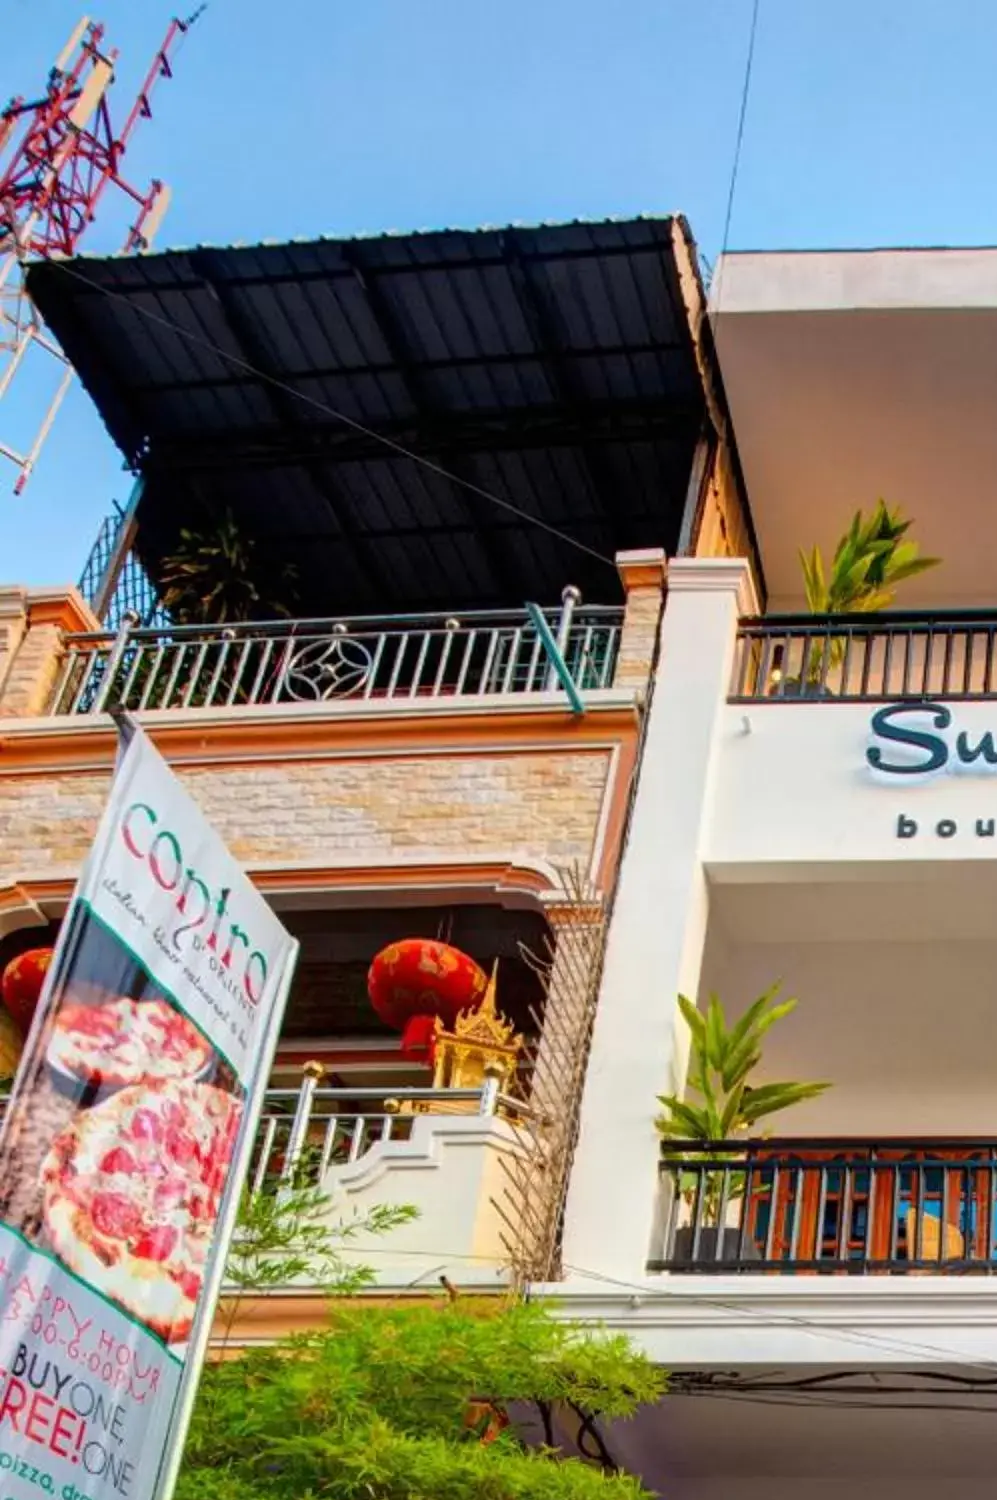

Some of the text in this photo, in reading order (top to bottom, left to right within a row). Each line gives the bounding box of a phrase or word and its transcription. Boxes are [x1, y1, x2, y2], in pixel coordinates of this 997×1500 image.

[11, 1343, 72, 1401] BUY
[99, 1328, 161, 1393] HOUR
[0, 1366, 136, 1497] REE! ONE
